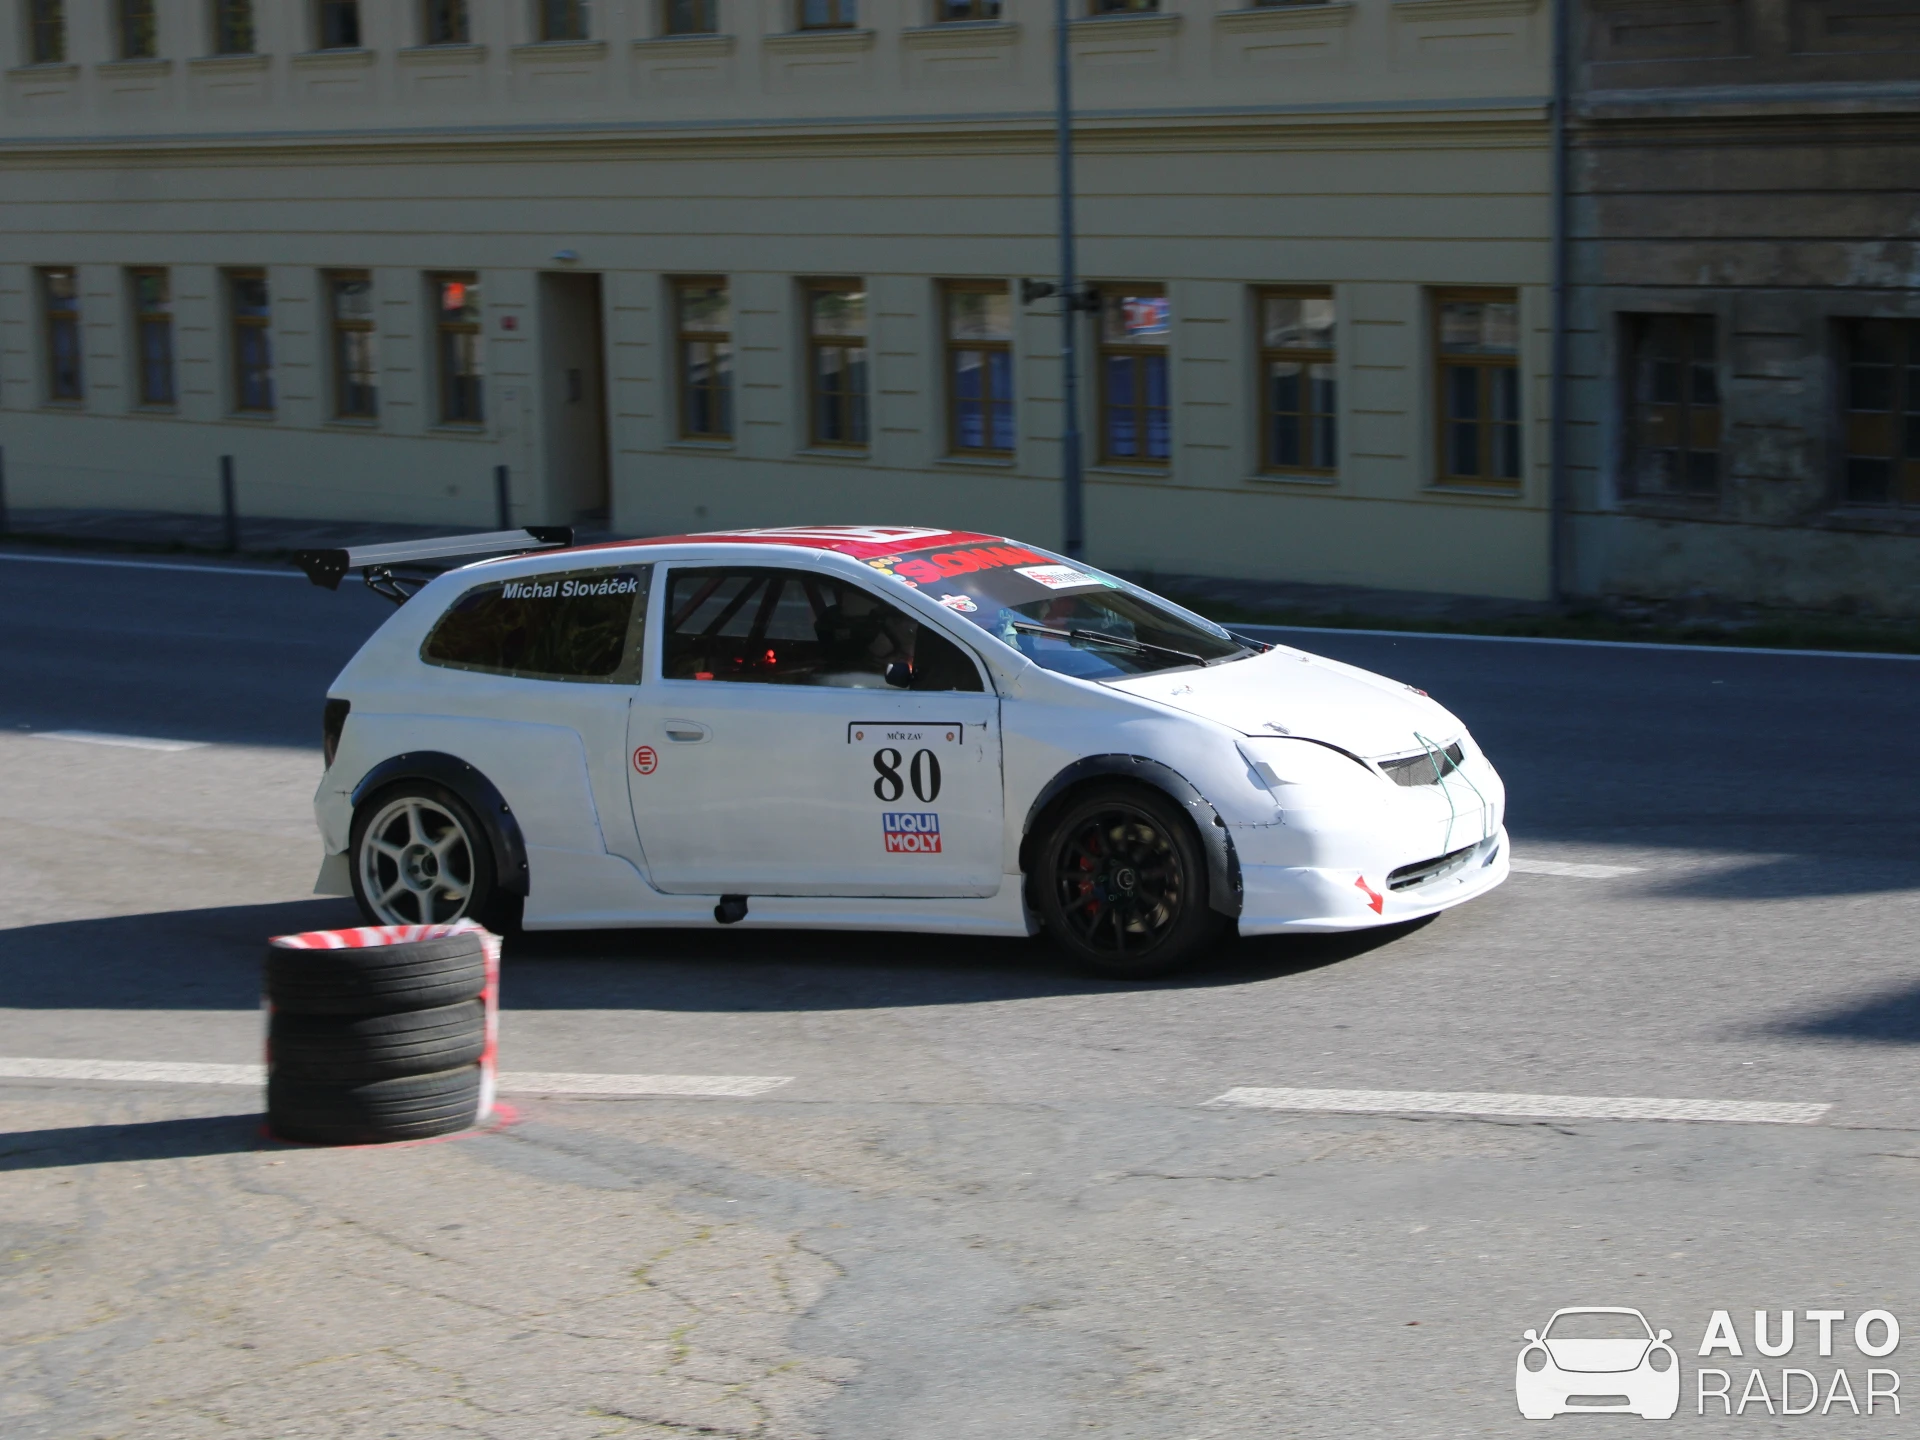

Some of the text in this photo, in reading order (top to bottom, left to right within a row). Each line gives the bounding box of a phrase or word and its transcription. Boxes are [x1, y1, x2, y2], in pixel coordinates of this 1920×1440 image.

[502, 577, 638, 599] Michal Slováček
[887, 731, 906, 740] MČR
[873, 747, 942, 804] 80
[884, 813, 939, 833] LIQUI
[886, 833, 940, 852] MOLY
